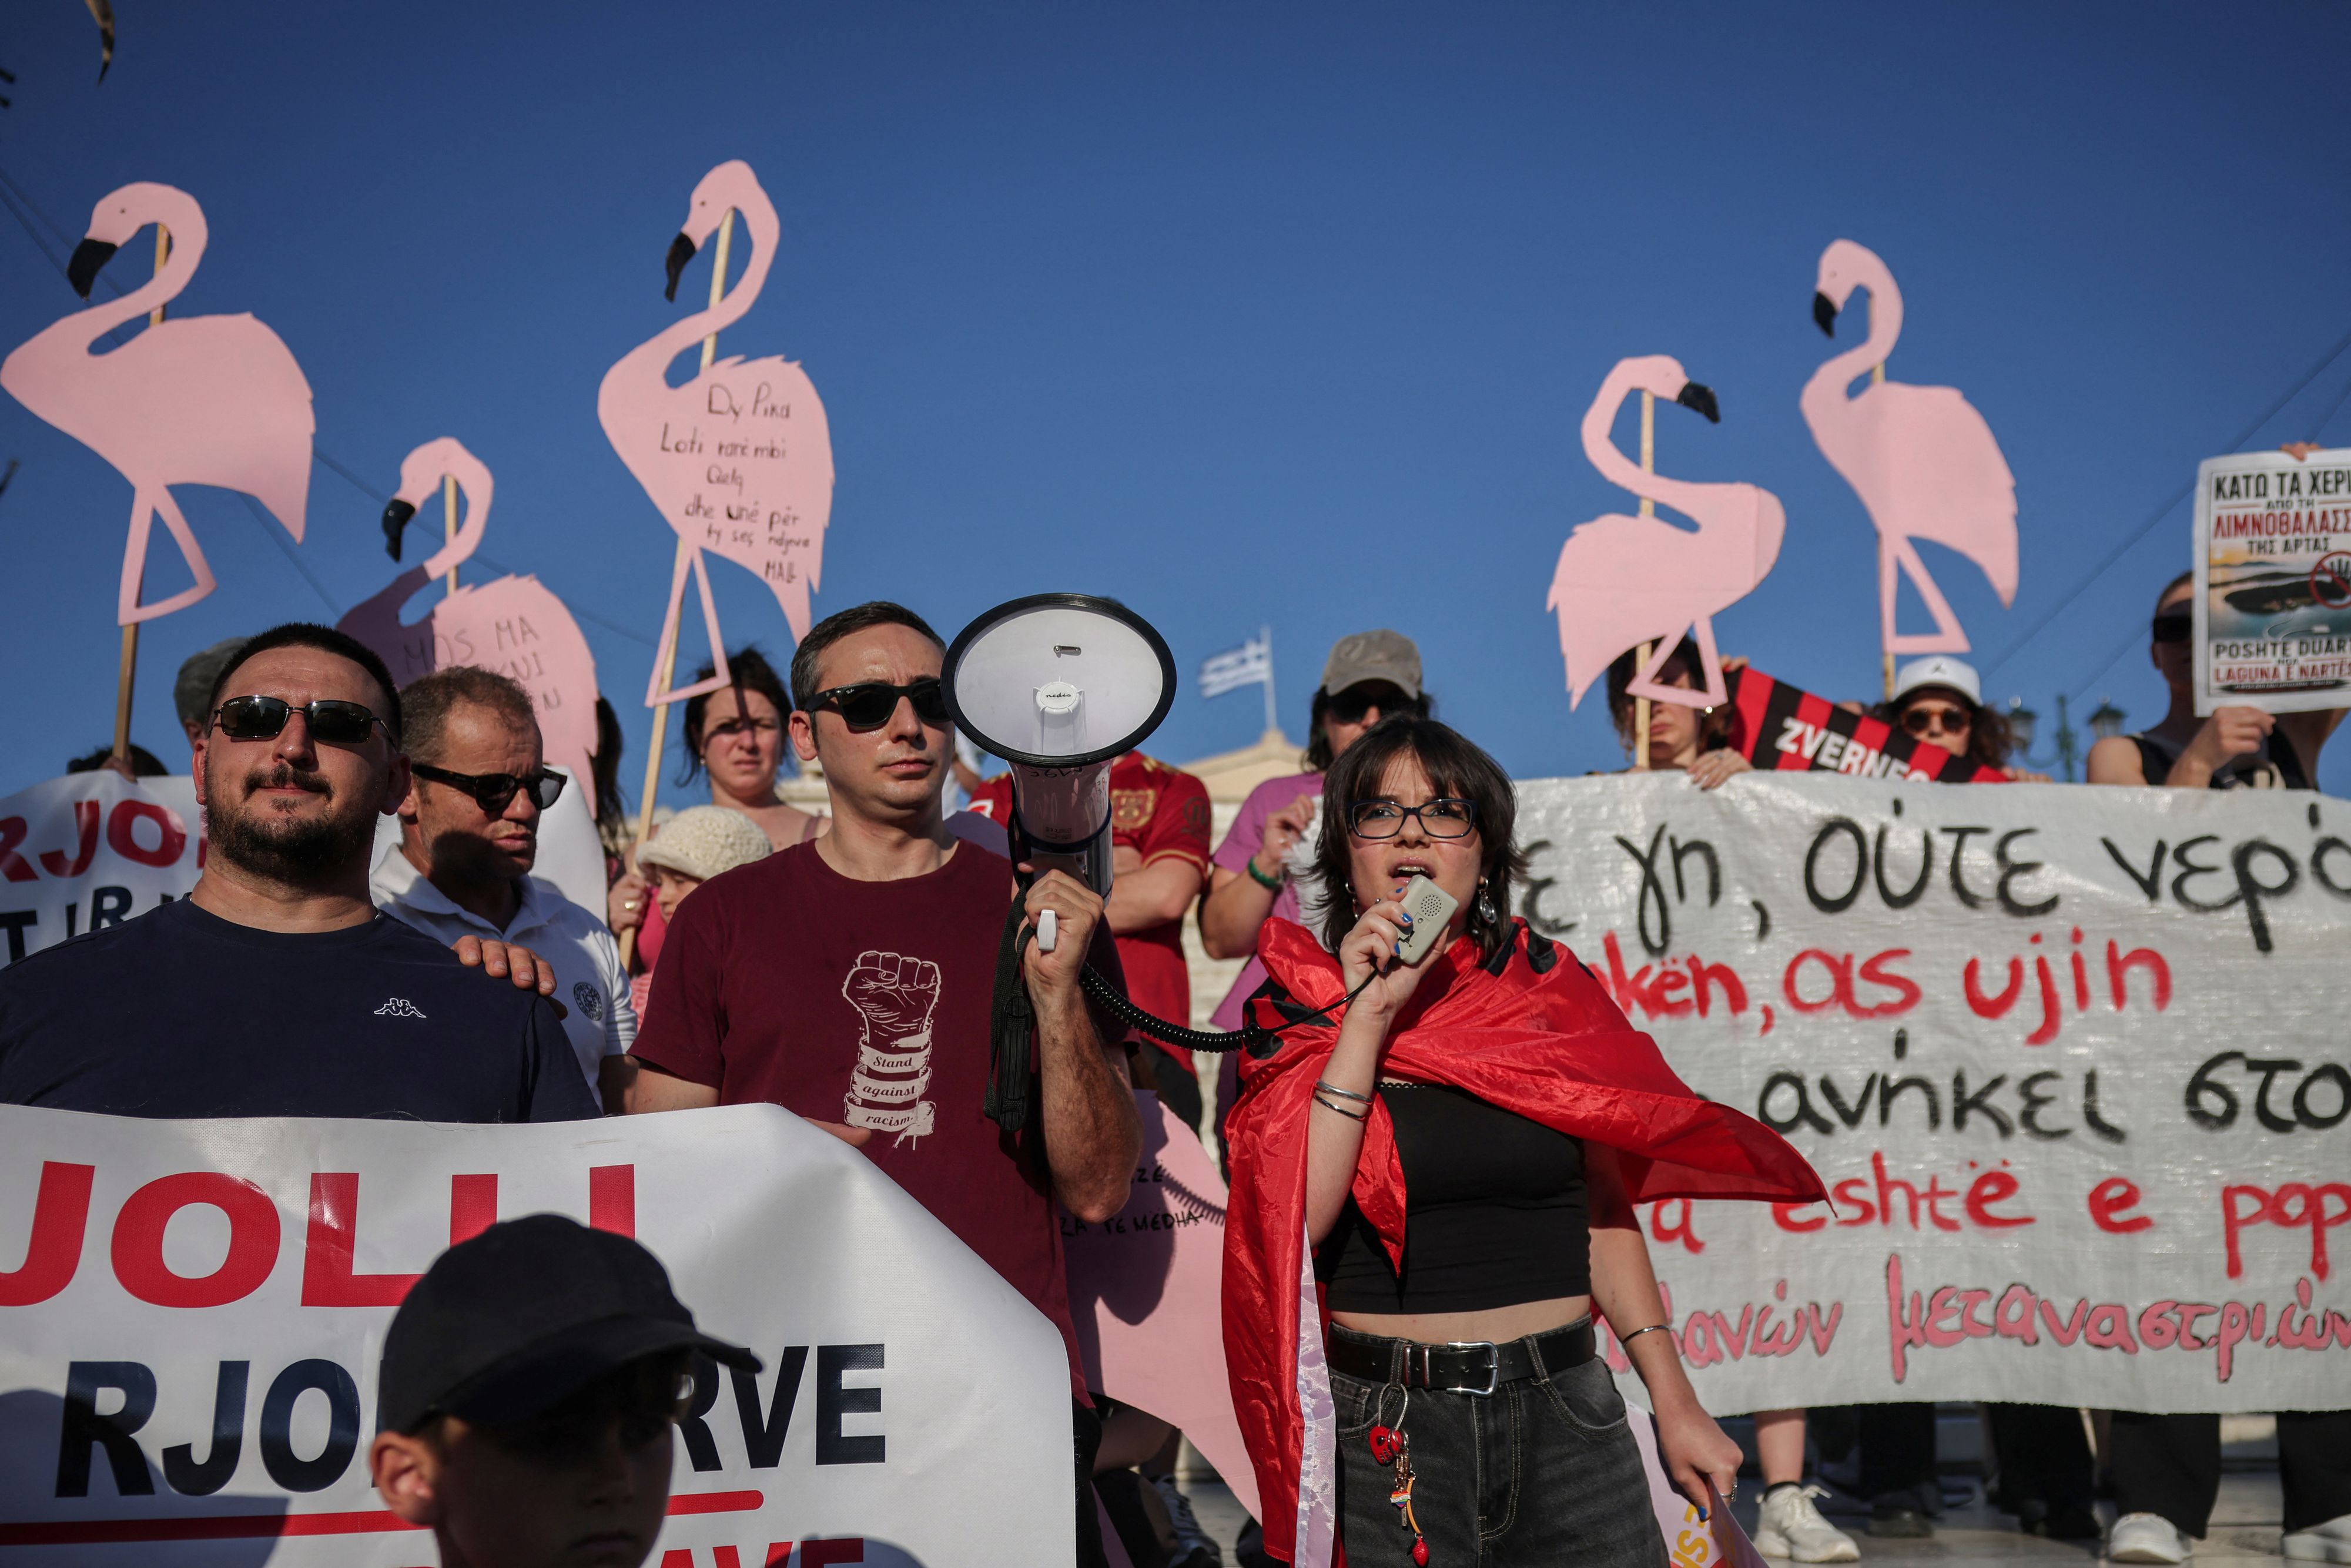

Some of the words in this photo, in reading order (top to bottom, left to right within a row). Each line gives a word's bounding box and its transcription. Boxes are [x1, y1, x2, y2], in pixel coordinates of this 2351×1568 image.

[661, 421, 703, 454] Loti
[2216, 474, 2267, 499] ΚΑΤΩ
[2276, 472, 2300, 496] ΤΑ
[2283, 537, 2332, 554] ΑΡΤΑΣ
[2299, 638, 2351, 656] DUAR
[2215, 666, 2281, 683] LAGUNA
[1587, 930, 1775, 1037] kën,
[1783, 948, 1922, 1020] as
[873, 1056, 913, 1068] Stand
[862, 1085, 915, 1098] against
[865, 1114, 914, 1125] racism.
[1635, 1199, 1706, 1255] a
[2088, 1177, 2155, 1234] e
[55, 1358, 383, 1497] RJO
